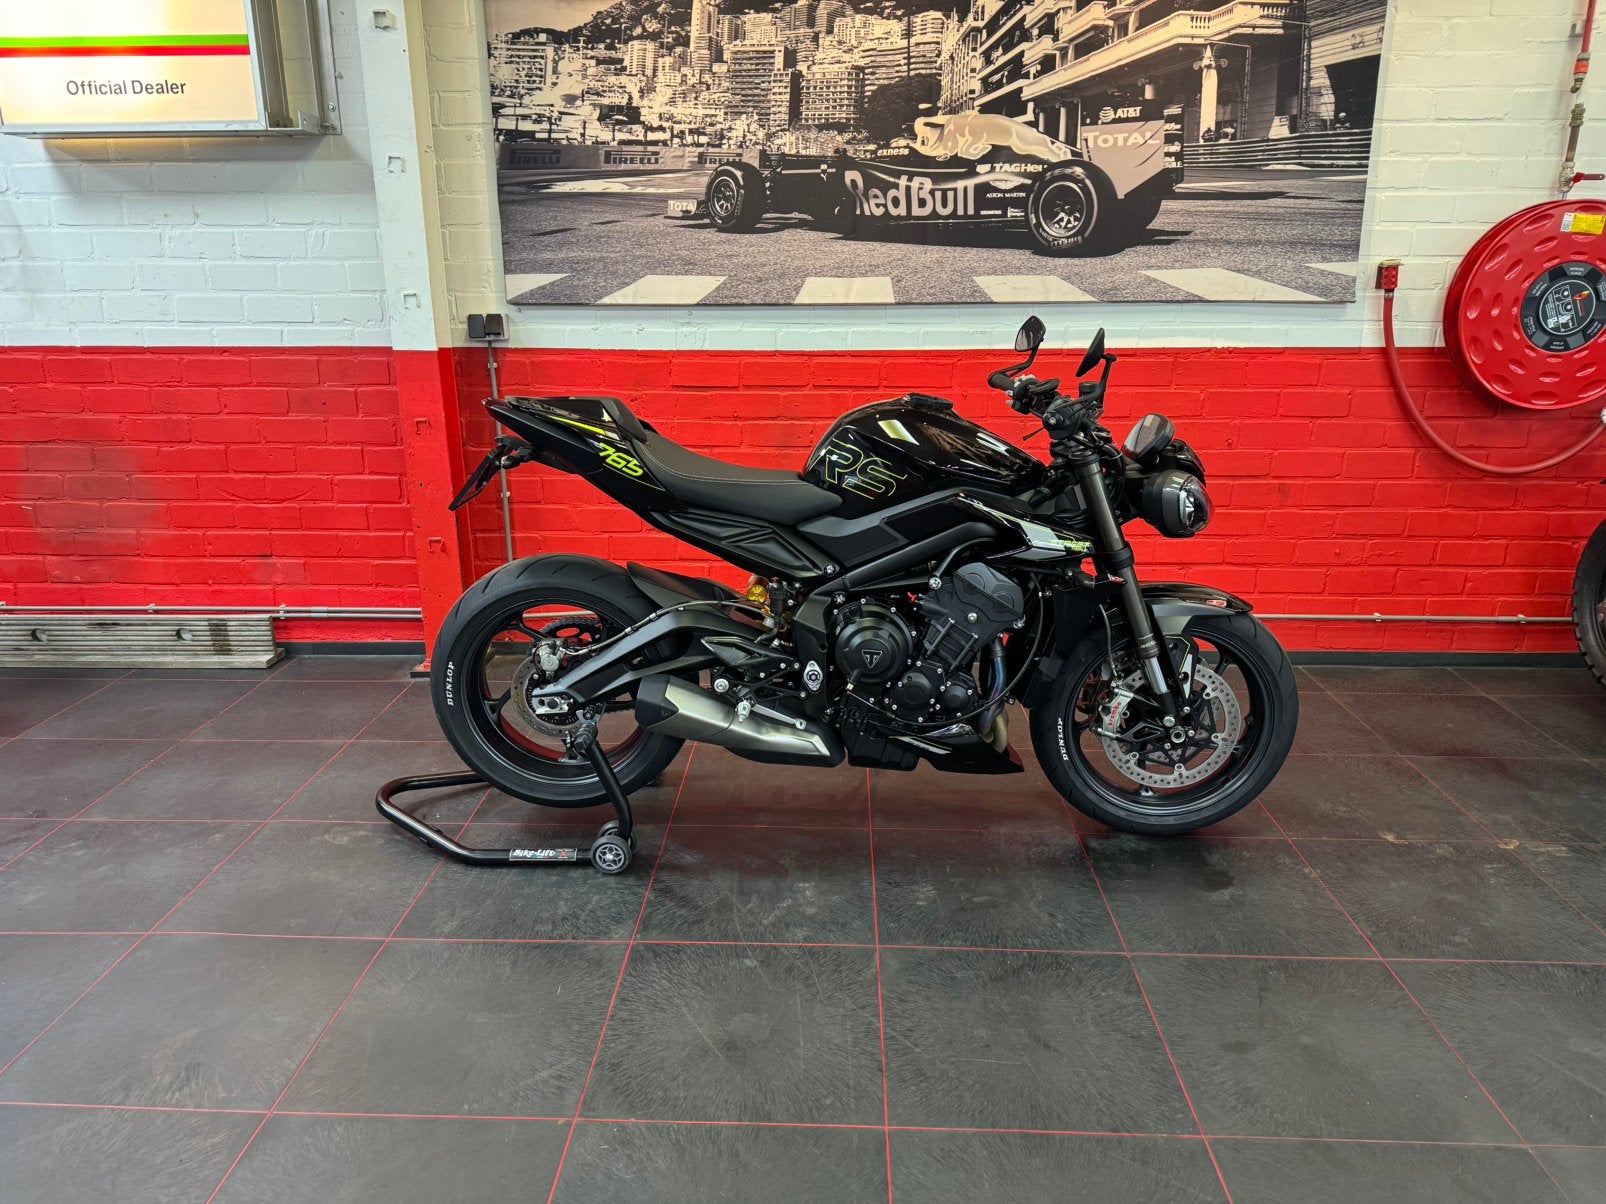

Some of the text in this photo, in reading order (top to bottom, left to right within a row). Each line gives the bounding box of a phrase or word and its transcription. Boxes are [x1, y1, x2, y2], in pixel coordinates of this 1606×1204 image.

[66, 79, 186, 96] Official Dealer
[1116, 106, 1143, 118] AT&T
[1082, 131, 1161, 148] TOTAL
[509, 149, 561, 165] PIRELLI
[603, 150, 660, 165] PIRELLI
[697, 151, 743, 164] PIRE
[876, 147, 910, 157] exness
[598, 442, 644, 477] 765
[808, 437, 908, 500] RS
[445, 661, 455, 707] DUNLOP
[1107, 701, 1122, 727] brembo
[1057, 717, 1069, 761] DUNLOP
